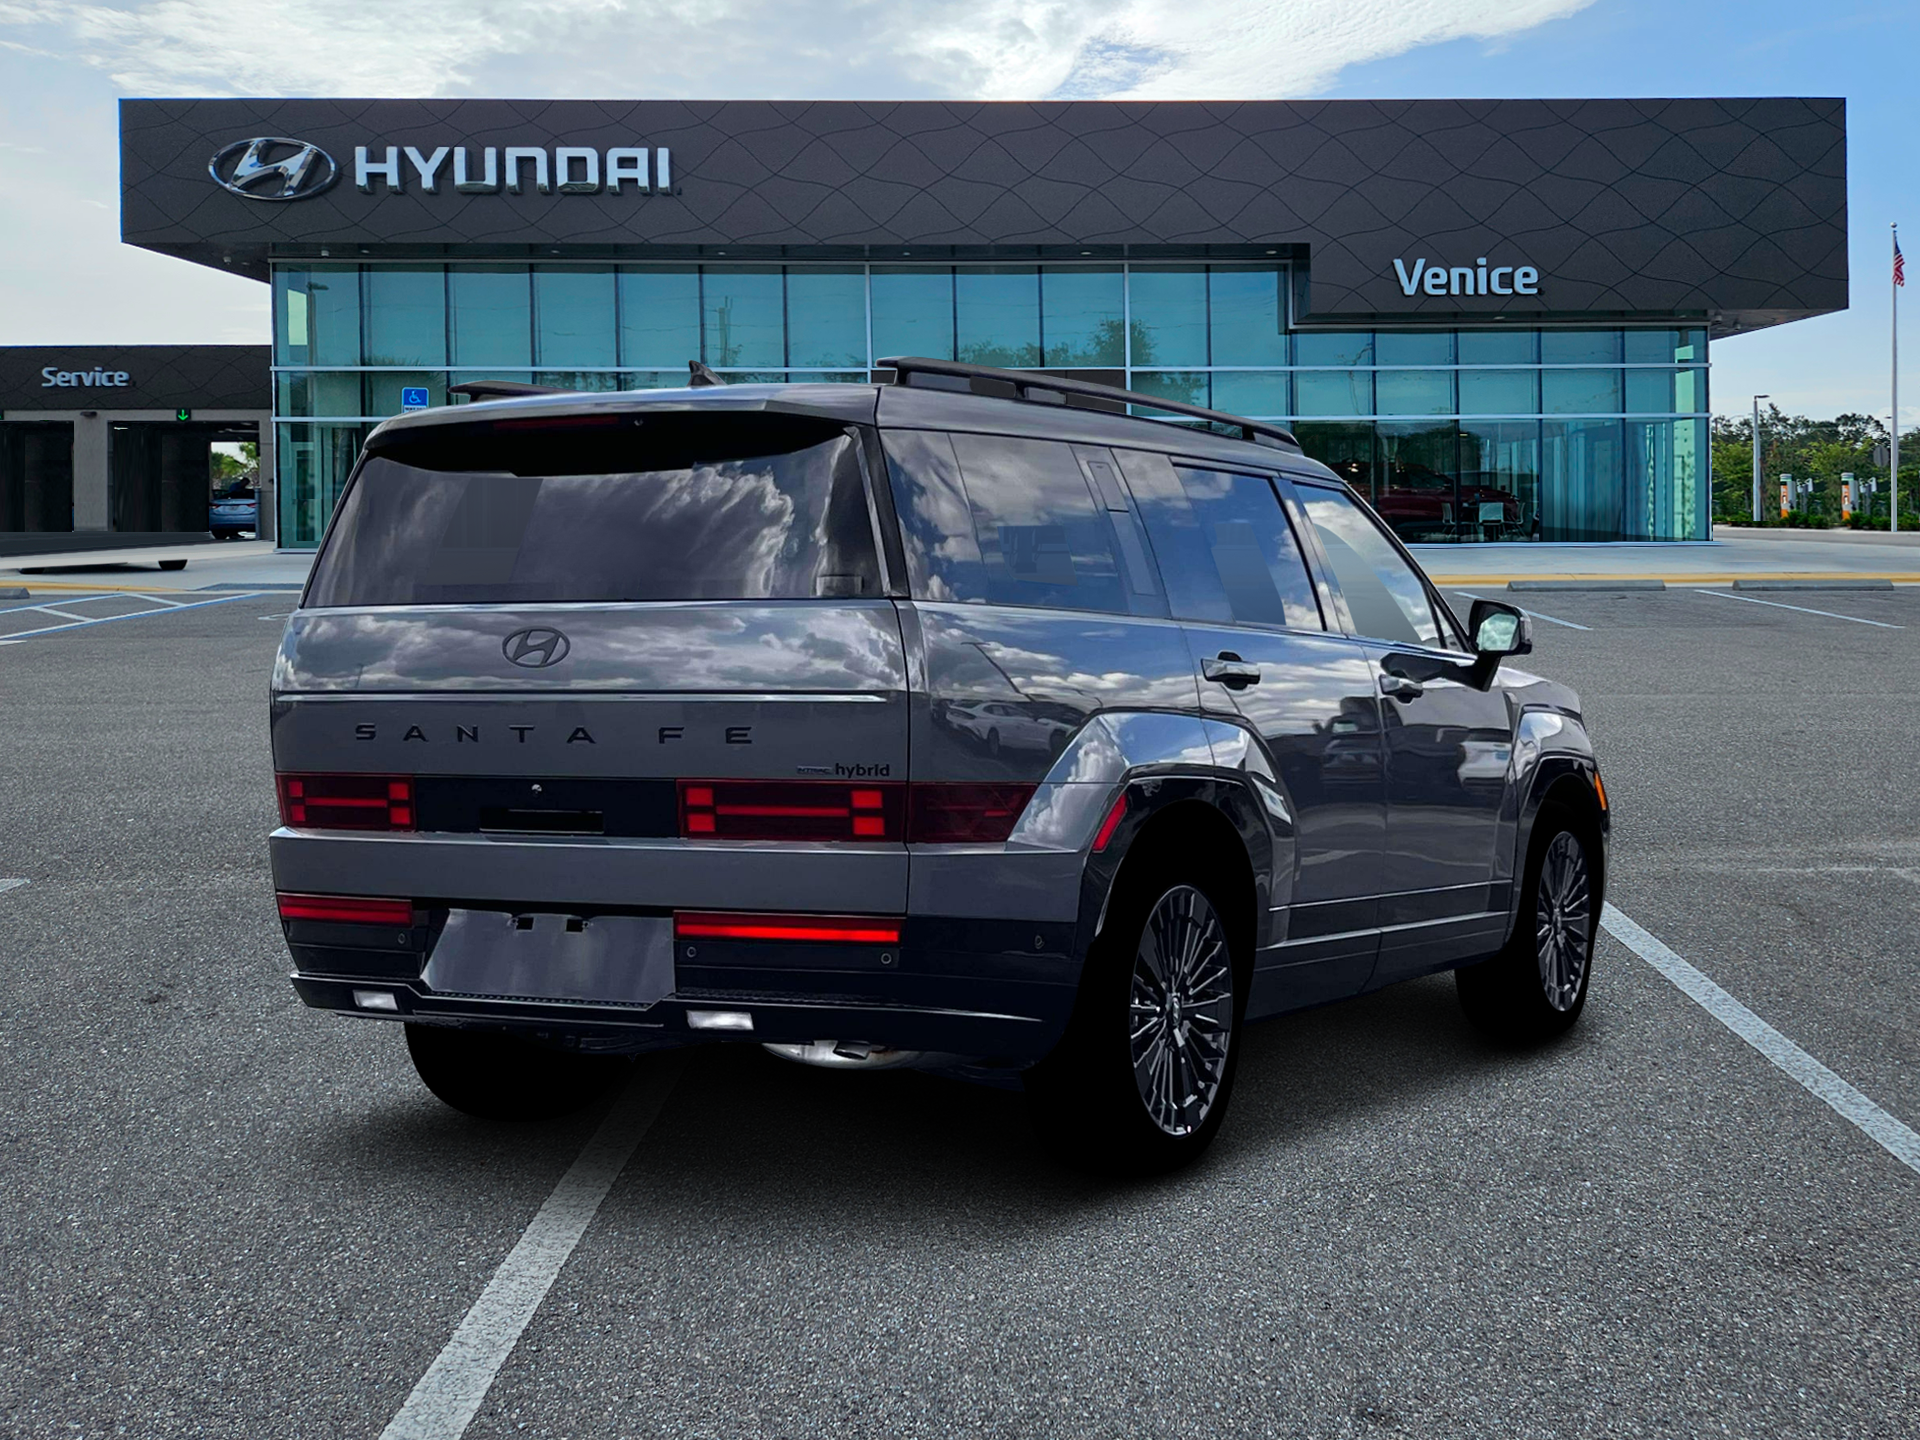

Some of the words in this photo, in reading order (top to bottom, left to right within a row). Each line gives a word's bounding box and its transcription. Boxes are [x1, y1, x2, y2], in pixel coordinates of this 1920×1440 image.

[354, 146, 671, 195] HYUNDAI
[1393, 257, 1539, 296] Venice
[41, 367, 130, 388] Service
[355, 722, 597, 745] SANTA
[658, 726, 753, 745] FE
[835, 762, 890, 779] hybrid
